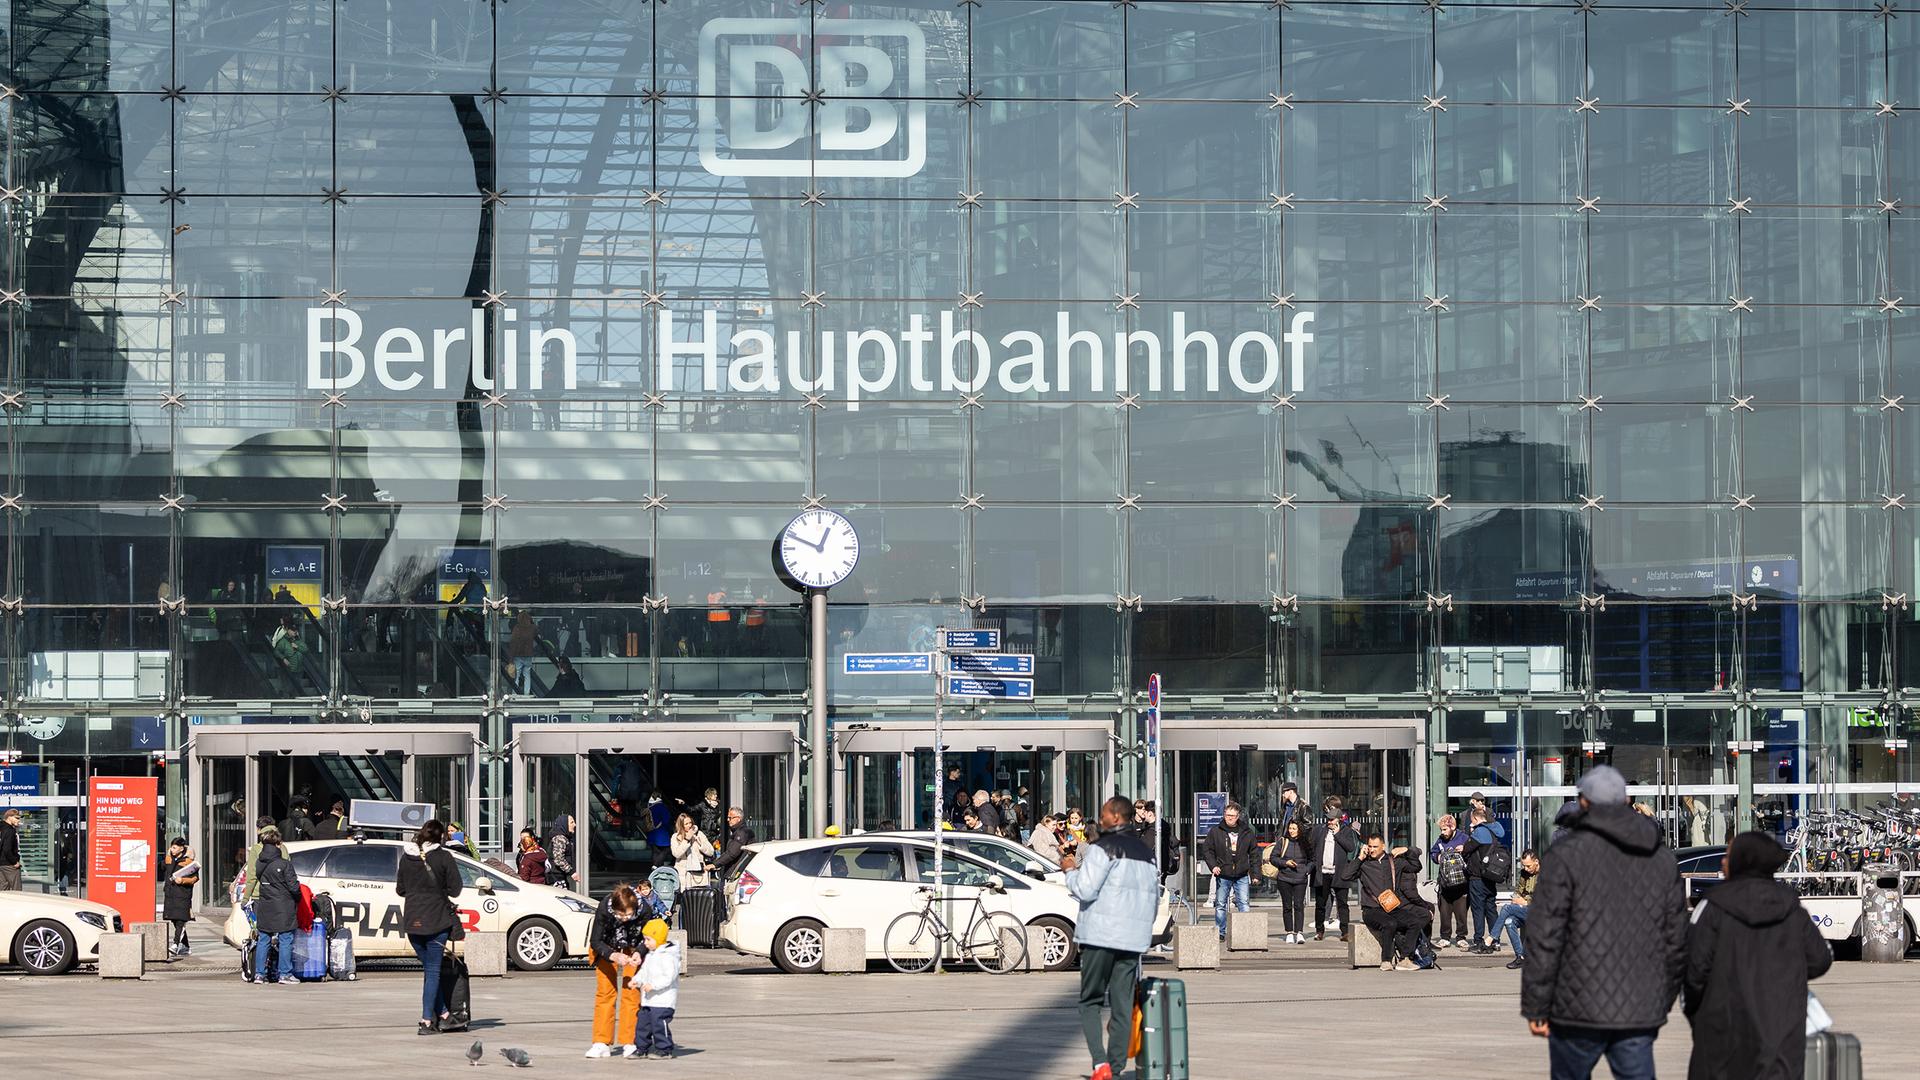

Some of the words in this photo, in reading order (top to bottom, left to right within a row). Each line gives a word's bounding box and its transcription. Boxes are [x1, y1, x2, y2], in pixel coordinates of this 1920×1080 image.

[729, 45, 898, 150] DB
[307, 307, 577, 390] Berlin
[659, 310, 1314, 411] Hauptbahnhof
[298, 563, 316, 573] A-E
[445, 563, 464, 573] E-G
[697, 562, 712, 576] 12
[1647, 571, 1669, 580] Abfahrt
[1515, 577, 1536, 587] Abfahrt
[527, 714, 560, 723] 11-16
[96, 797, 109, 805] HIN
[110, 797, 126, 805] UND
[126, 797, 143, 805] WEG
[96, 806, 107, 814] AM
[108, 806, 122, 814] HBF
[335, 901, 406, 939] PLA
